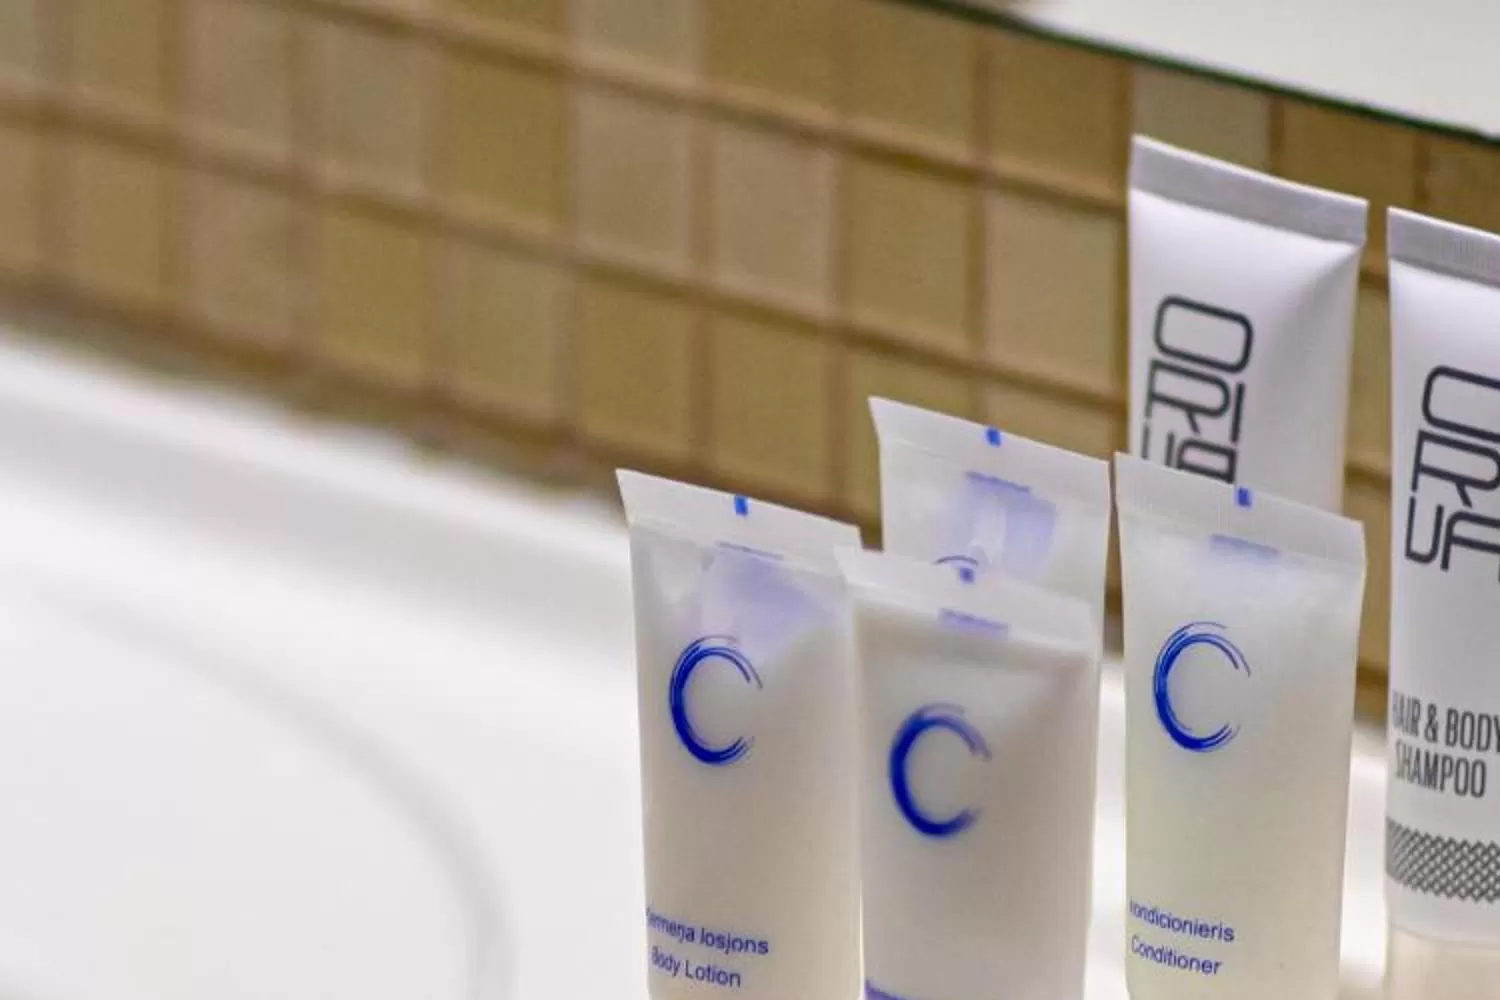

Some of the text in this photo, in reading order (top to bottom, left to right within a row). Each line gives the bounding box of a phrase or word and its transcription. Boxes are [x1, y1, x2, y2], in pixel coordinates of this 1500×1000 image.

[1424, 703, 1438, 743] &
[1396, 739, 1486, 799] SHAMPOO
[700, 927, 769, 955] losjons
[1132, 934, 1221, 975] Conditioner
[685, 960, 741, 988] Lotion
